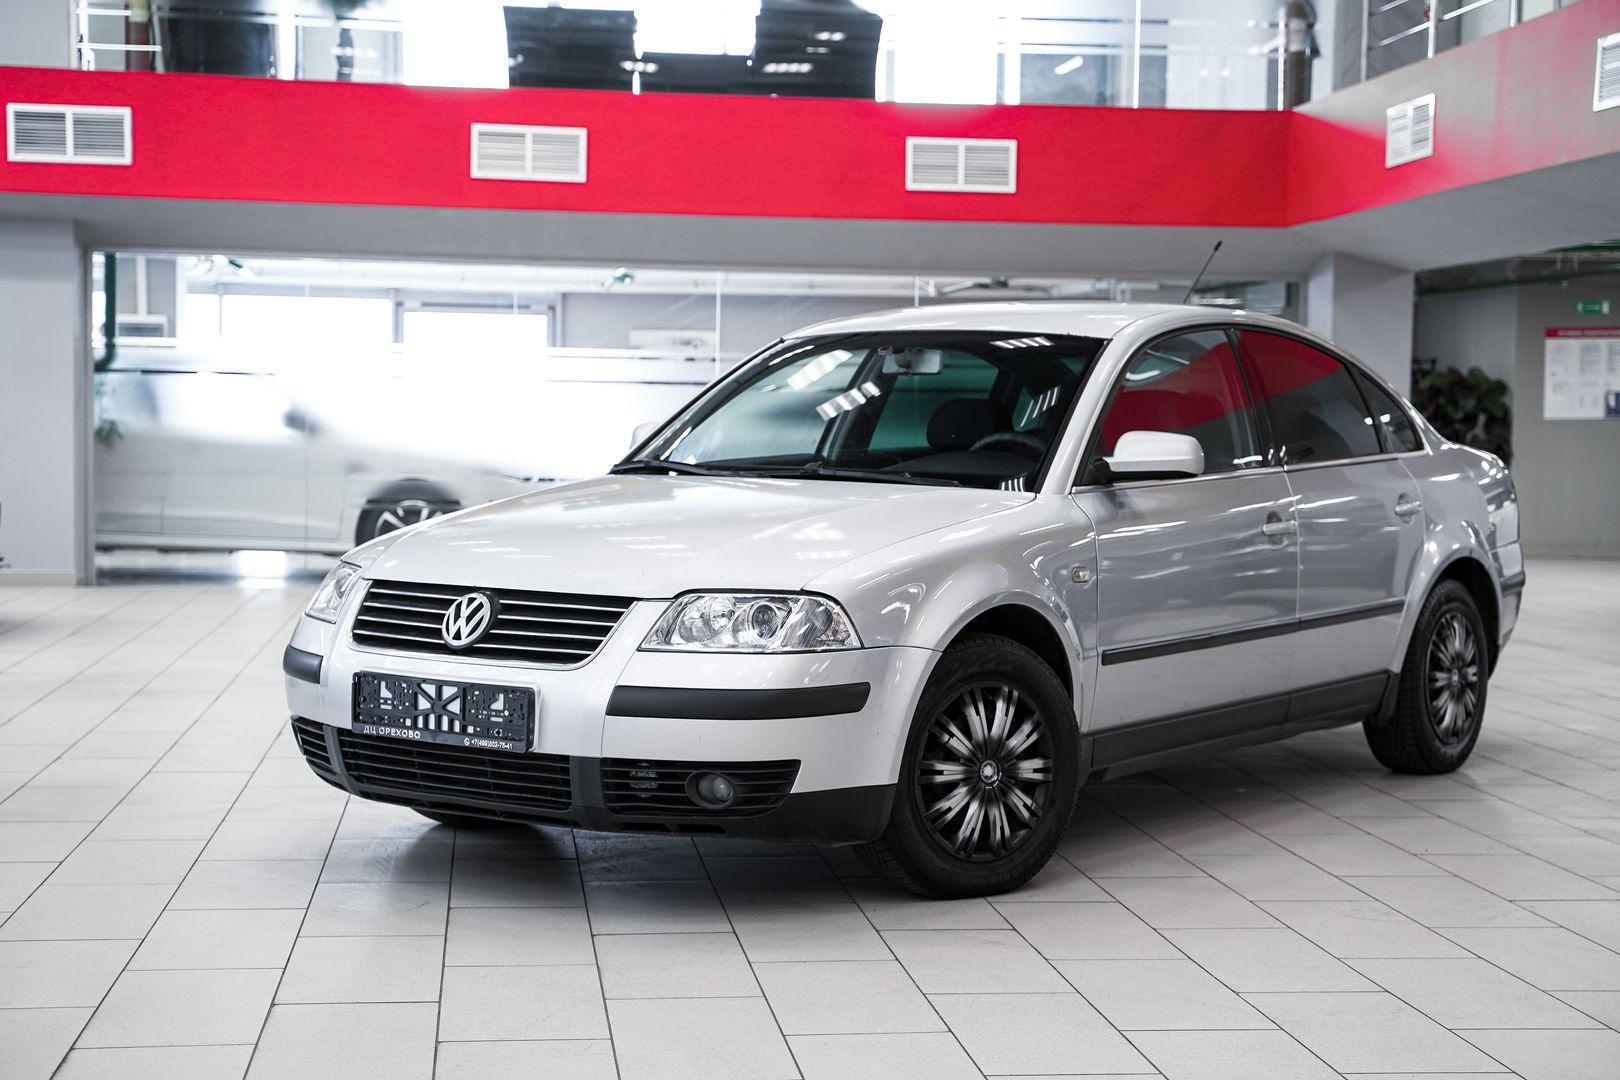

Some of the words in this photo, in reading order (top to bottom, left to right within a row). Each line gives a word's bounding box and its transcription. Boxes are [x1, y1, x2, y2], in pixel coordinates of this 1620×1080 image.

[444, 594, 489, 645] VW
[363, 725, 376, 735] ДЦ
[378, 727, 421, 739] ОРЕХОВО
